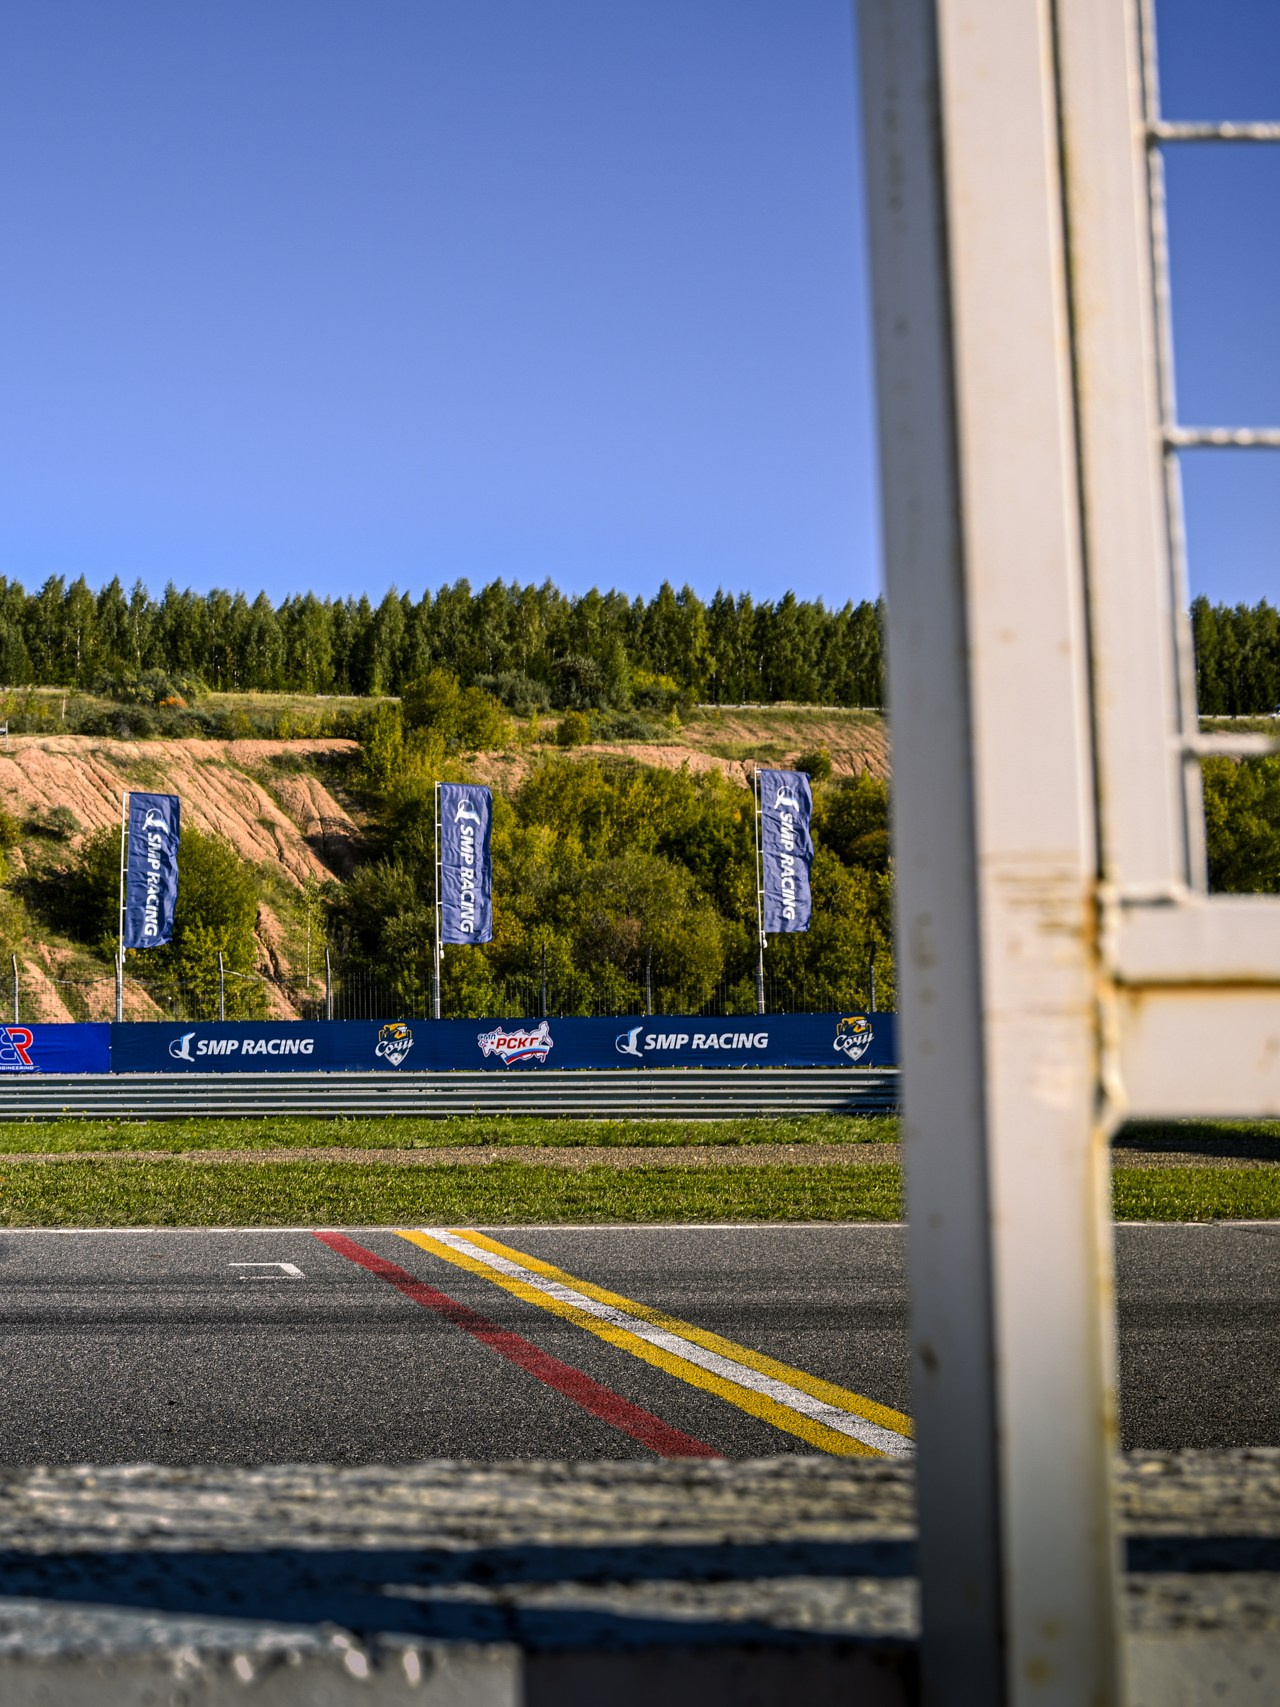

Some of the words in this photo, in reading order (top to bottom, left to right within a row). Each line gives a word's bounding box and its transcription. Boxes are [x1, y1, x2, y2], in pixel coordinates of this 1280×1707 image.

[460, 824, 474, 865] SMP
[780, 811, 794, 851] SMP
[147, 832, 162, 871] SMP
[144, 871, 161, 937] RACING
[460, 866, 474, 933] RACING
[780, 852, 796, 920] RACING
[196, 1039, 239, 1055] SMP
[241, 1038, 315, 1055] RACING
[644, 1033, 688, 1050] SMP
[691, 1032, 769, 1049] RACING
